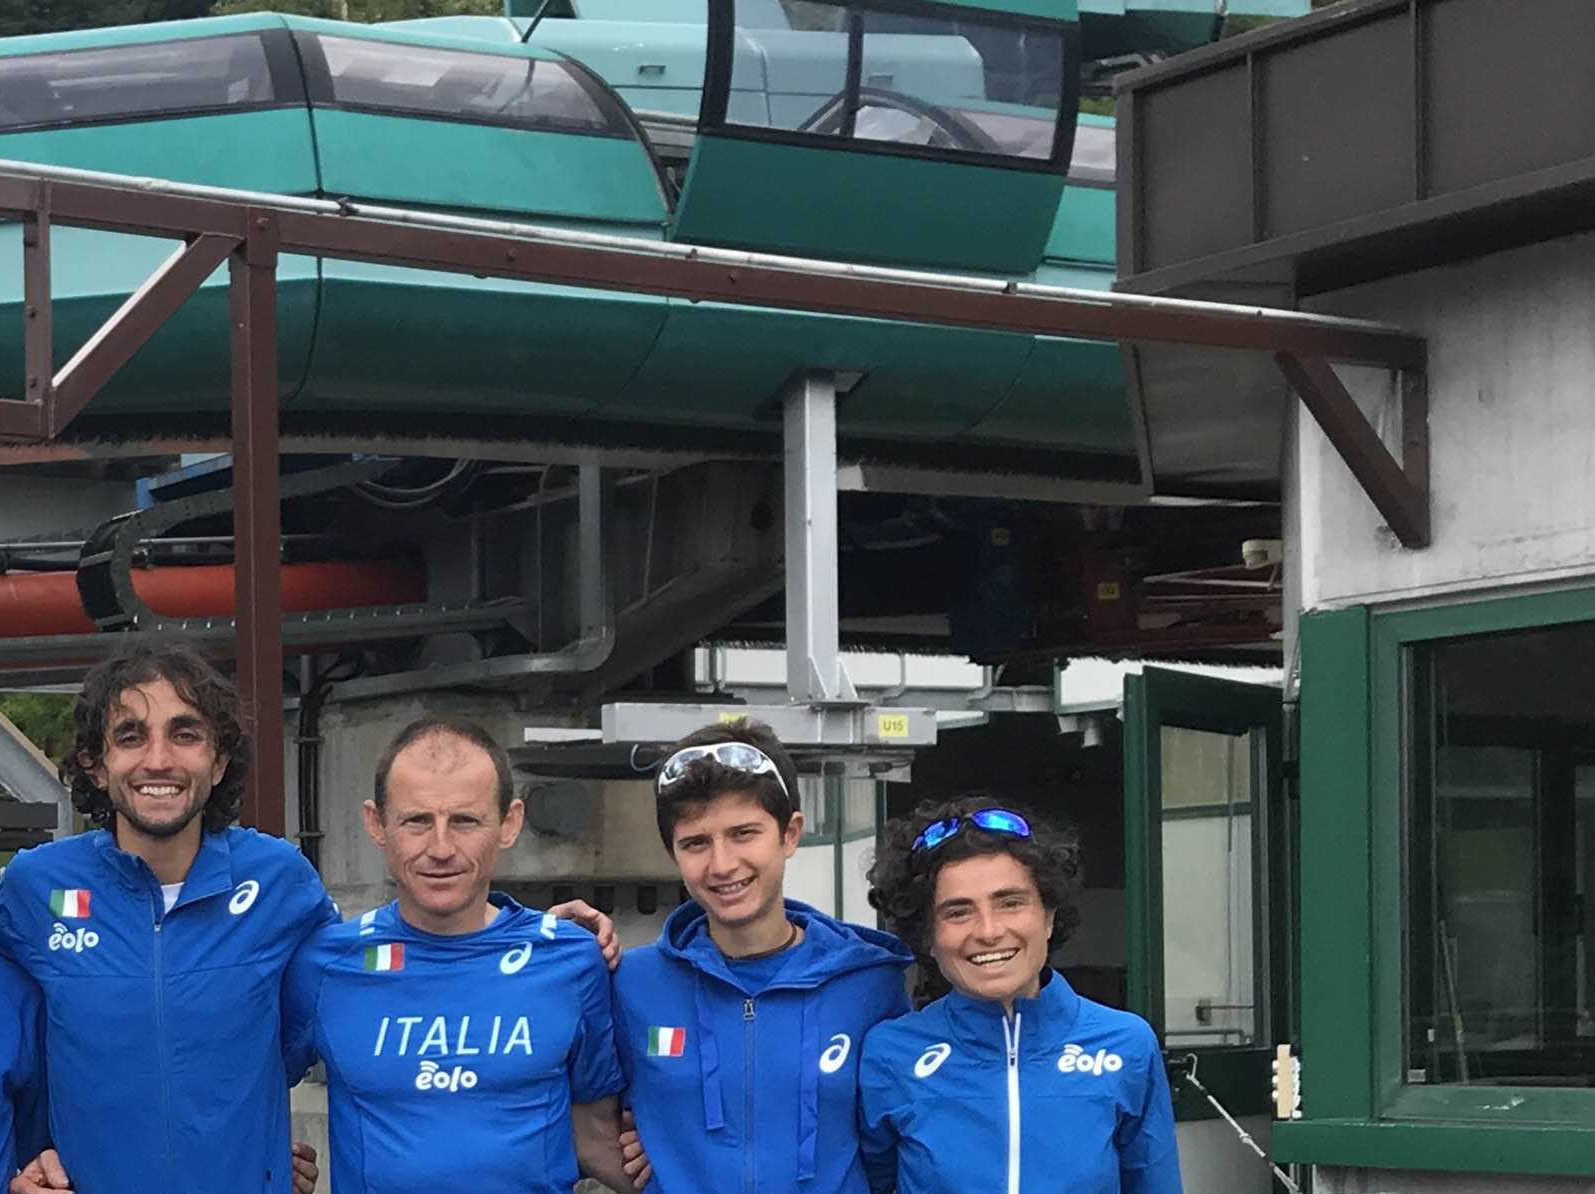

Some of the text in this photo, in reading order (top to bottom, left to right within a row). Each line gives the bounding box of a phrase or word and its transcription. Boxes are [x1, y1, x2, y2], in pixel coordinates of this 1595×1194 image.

[882, 720, 903, 732] U15
[48, 921, 100, 954] eolo
[373, 1015, 534, 1056] ITALIA
[414, 1060, 478, 1092] eolo
[1057, 1043, 1123, 1076] eolo
